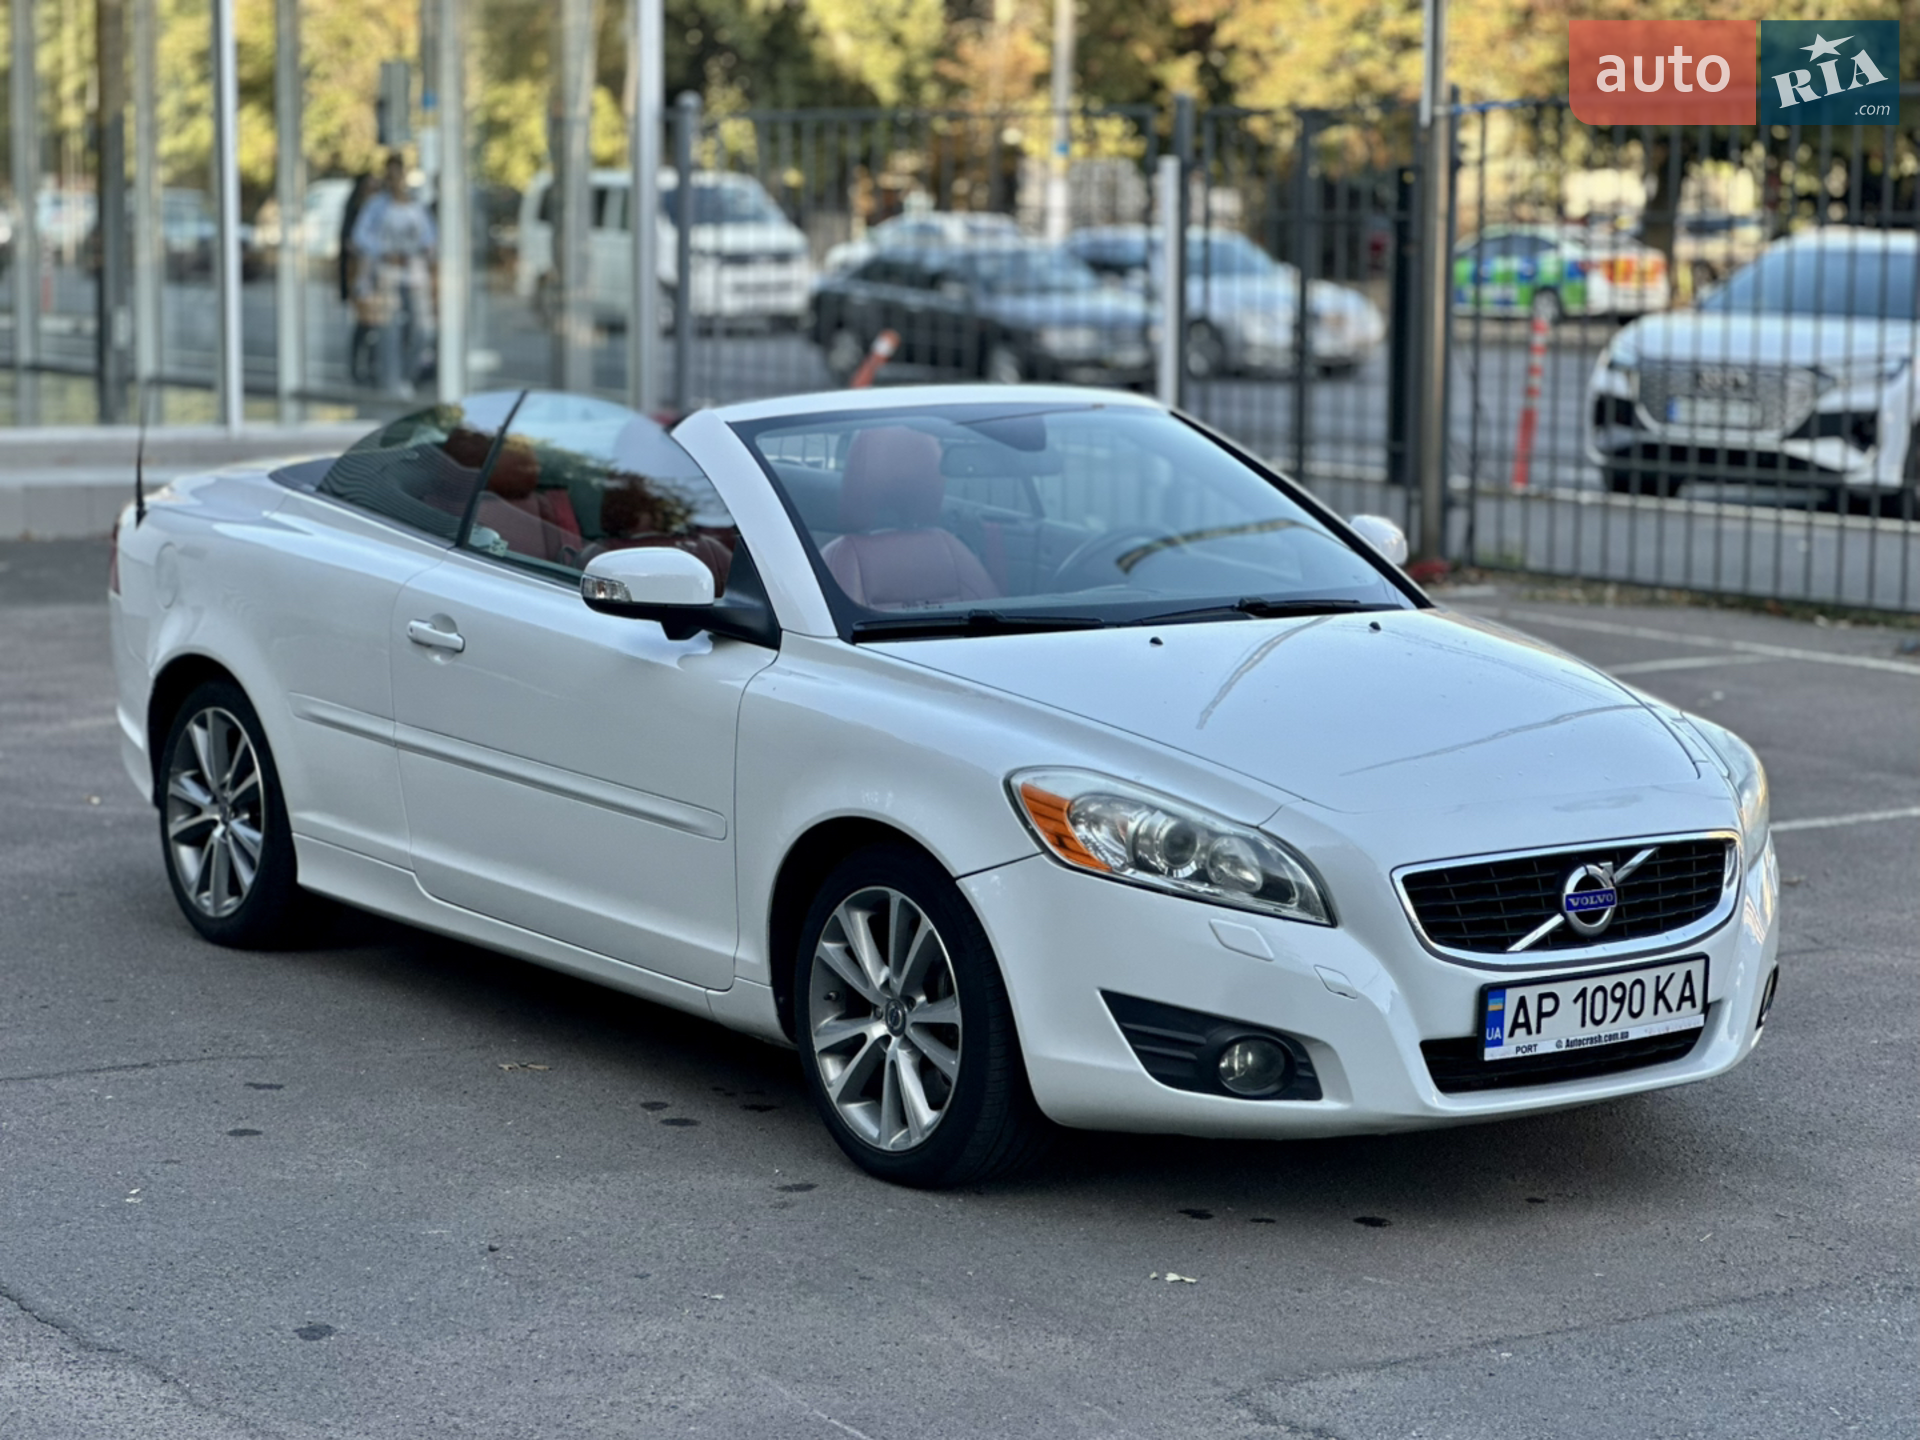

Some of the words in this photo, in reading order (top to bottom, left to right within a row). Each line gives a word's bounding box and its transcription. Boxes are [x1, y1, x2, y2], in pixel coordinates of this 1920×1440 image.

[1568, 894, 1614, 907] VOLVO
[1508, 991, 1560, 1038] AP
[1572, 978, 1646, 1028] 1090
[1653, 969, 1698, 1016] KA
[1486, 1027, 1502, 1040] UA
[1515, 1043, 1538, 1054] PORT
